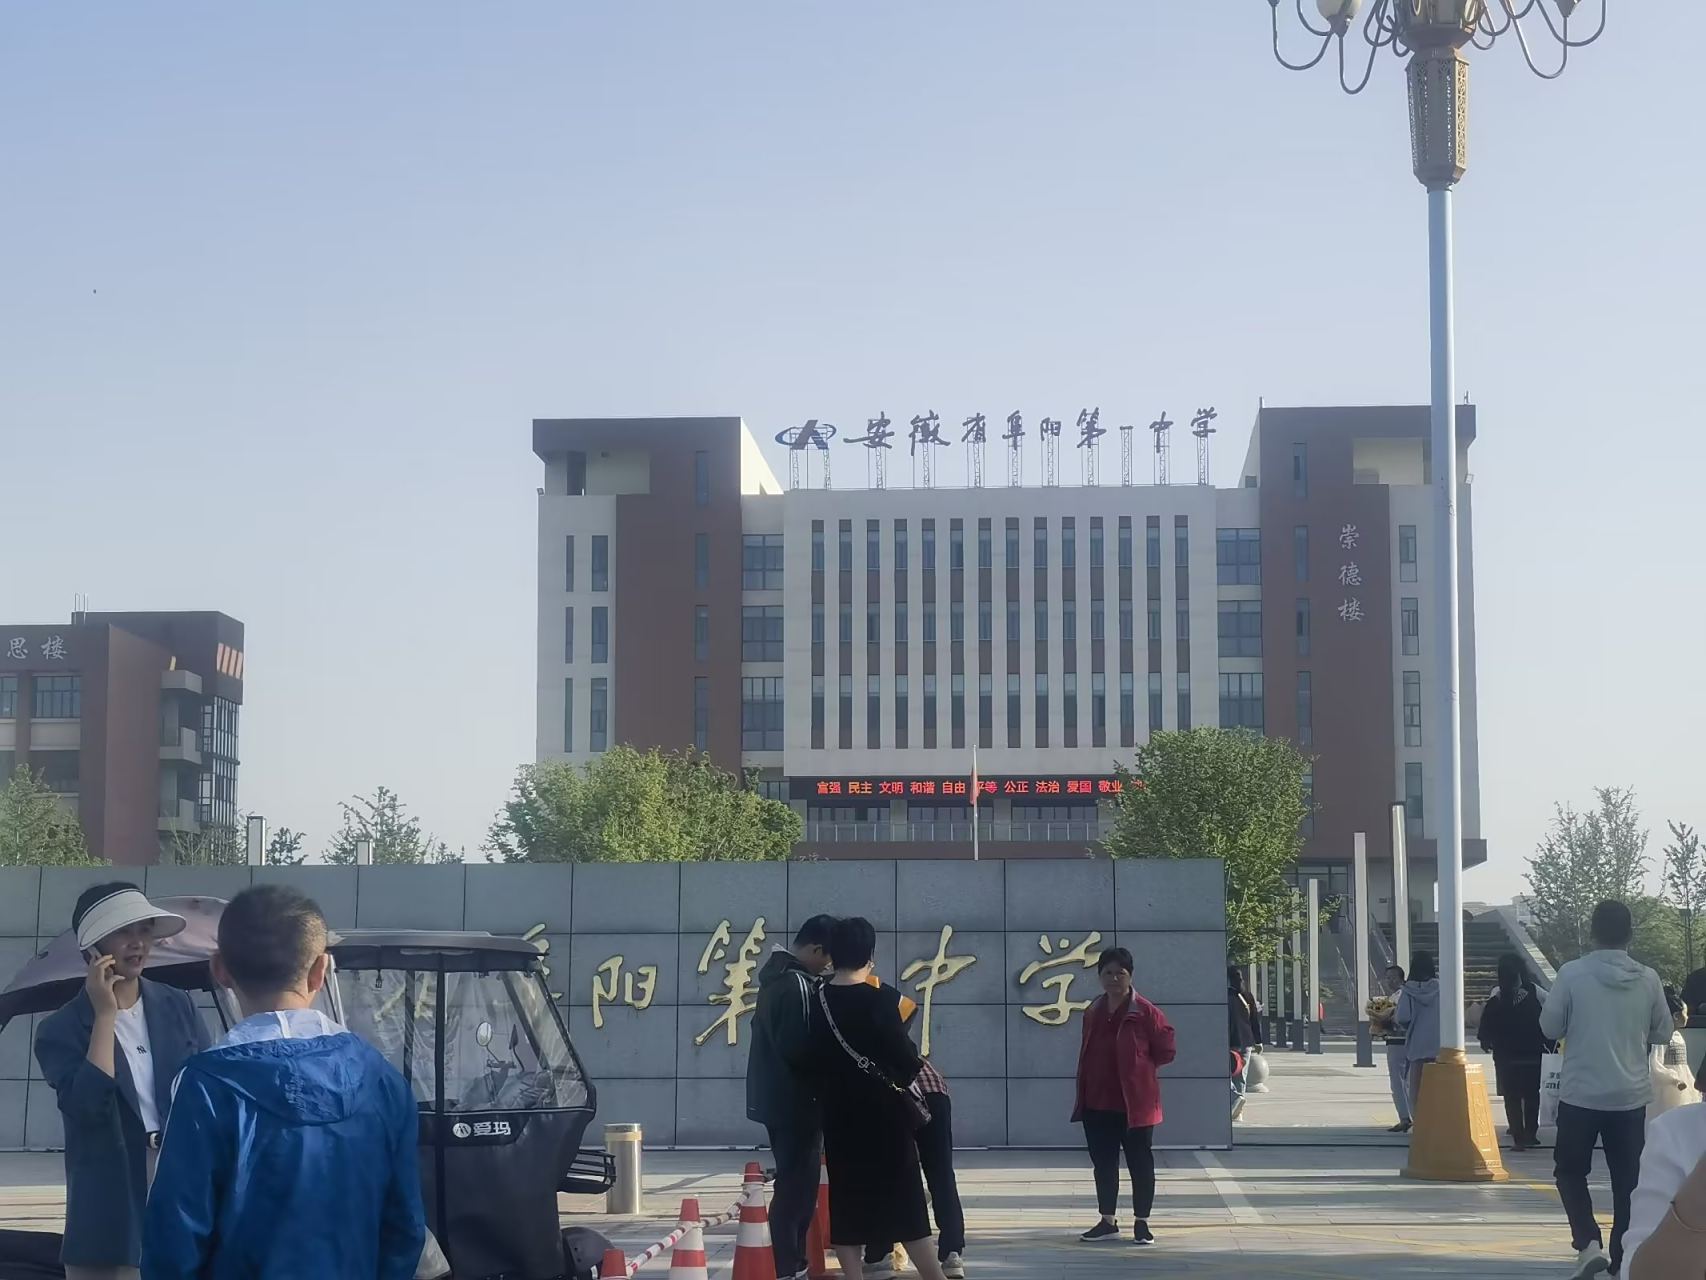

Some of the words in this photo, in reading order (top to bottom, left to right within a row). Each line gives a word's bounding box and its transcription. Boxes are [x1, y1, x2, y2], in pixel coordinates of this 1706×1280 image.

[843, 407, 1217, 456] 安徽省阜阳第一中学
[1338, 523, 1364, 621] 崇德楼
[817, 781, 841, 795] 富强
[848, 781, 872, 795] 民主
[879, 781, 904, 795] 文明
[910, 781, 935, 795] 和谐
[942, 780, 966, 794] 自由
[1004, 780, 1029, 793] 公正
[1036, 780, 1060, 793] 法治
[1067, 780, 1092, 793] 爱国
[1098, 780, 1123, 793] 敬业
[473, 1121, 511, 1137] 爱玛
